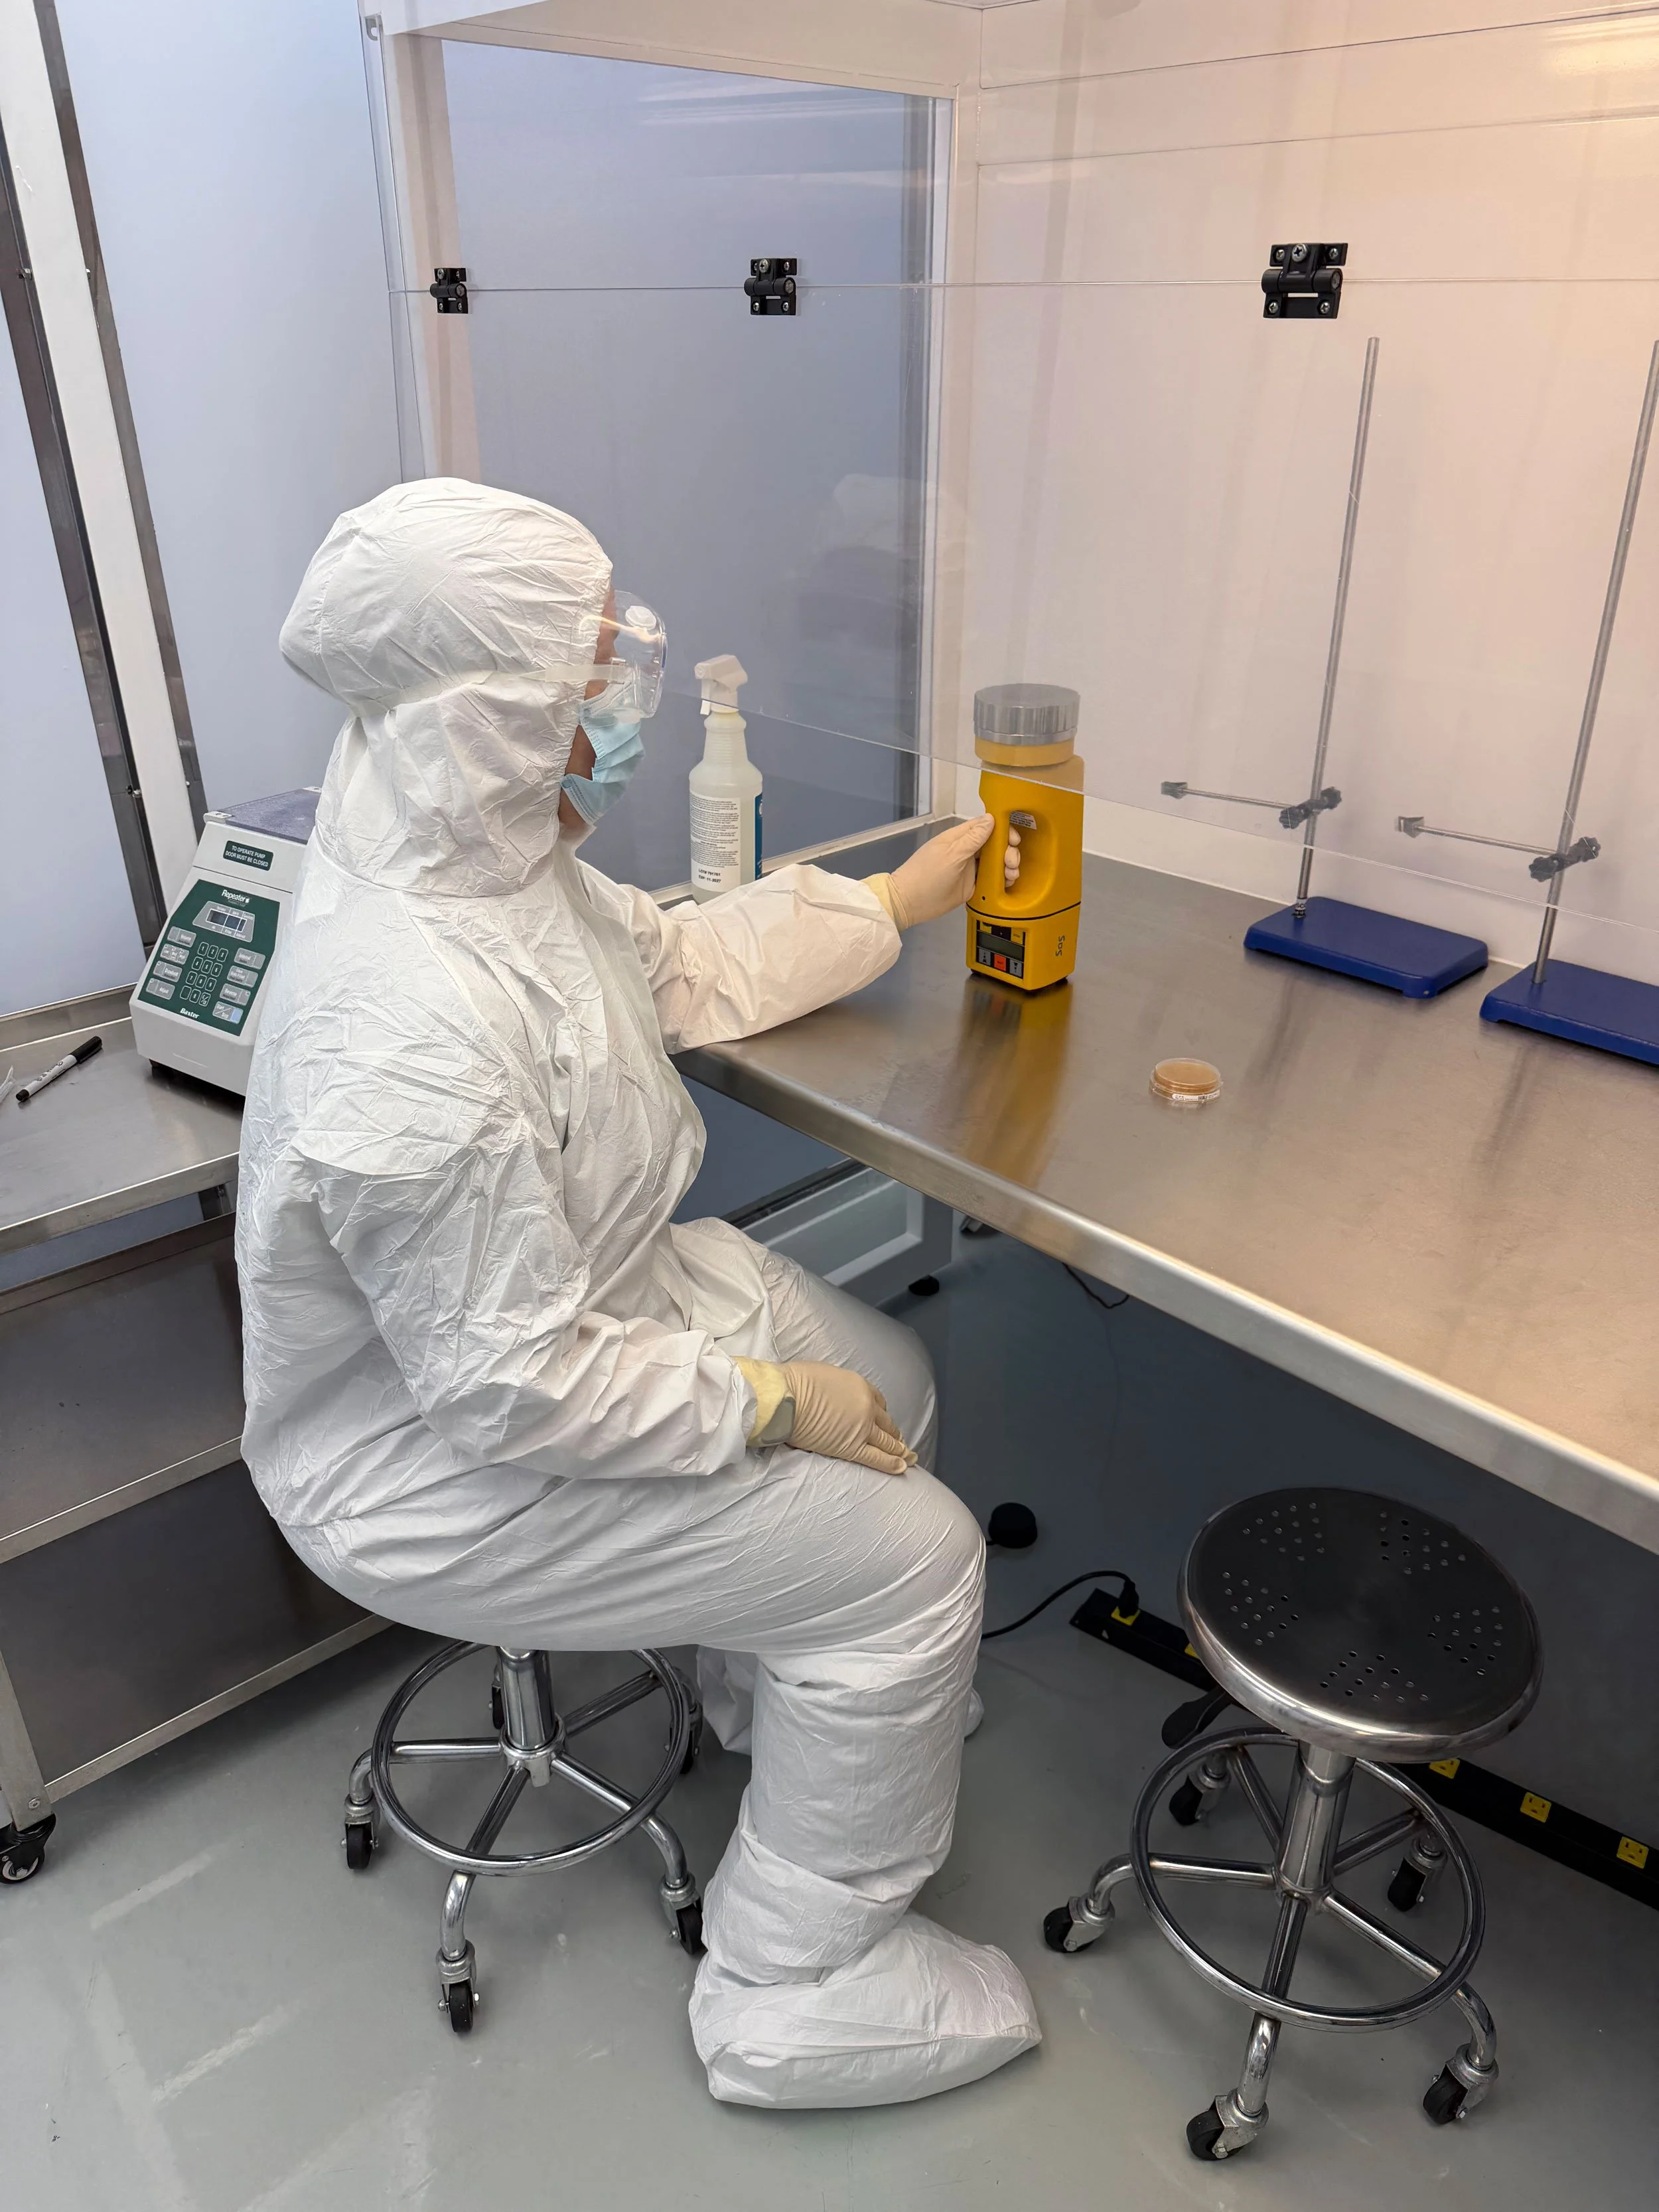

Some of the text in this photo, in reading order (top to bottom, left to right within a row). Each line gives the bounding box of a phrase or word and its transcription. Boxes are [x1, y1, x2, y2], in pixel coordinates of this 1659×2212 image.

[237, 847, 254, 856] OPERATE
[253, 859, 269, 867] CLOSED
[221, 889, 246, 903] Repeater
[180, 1007, 200, 1019] Baxter
